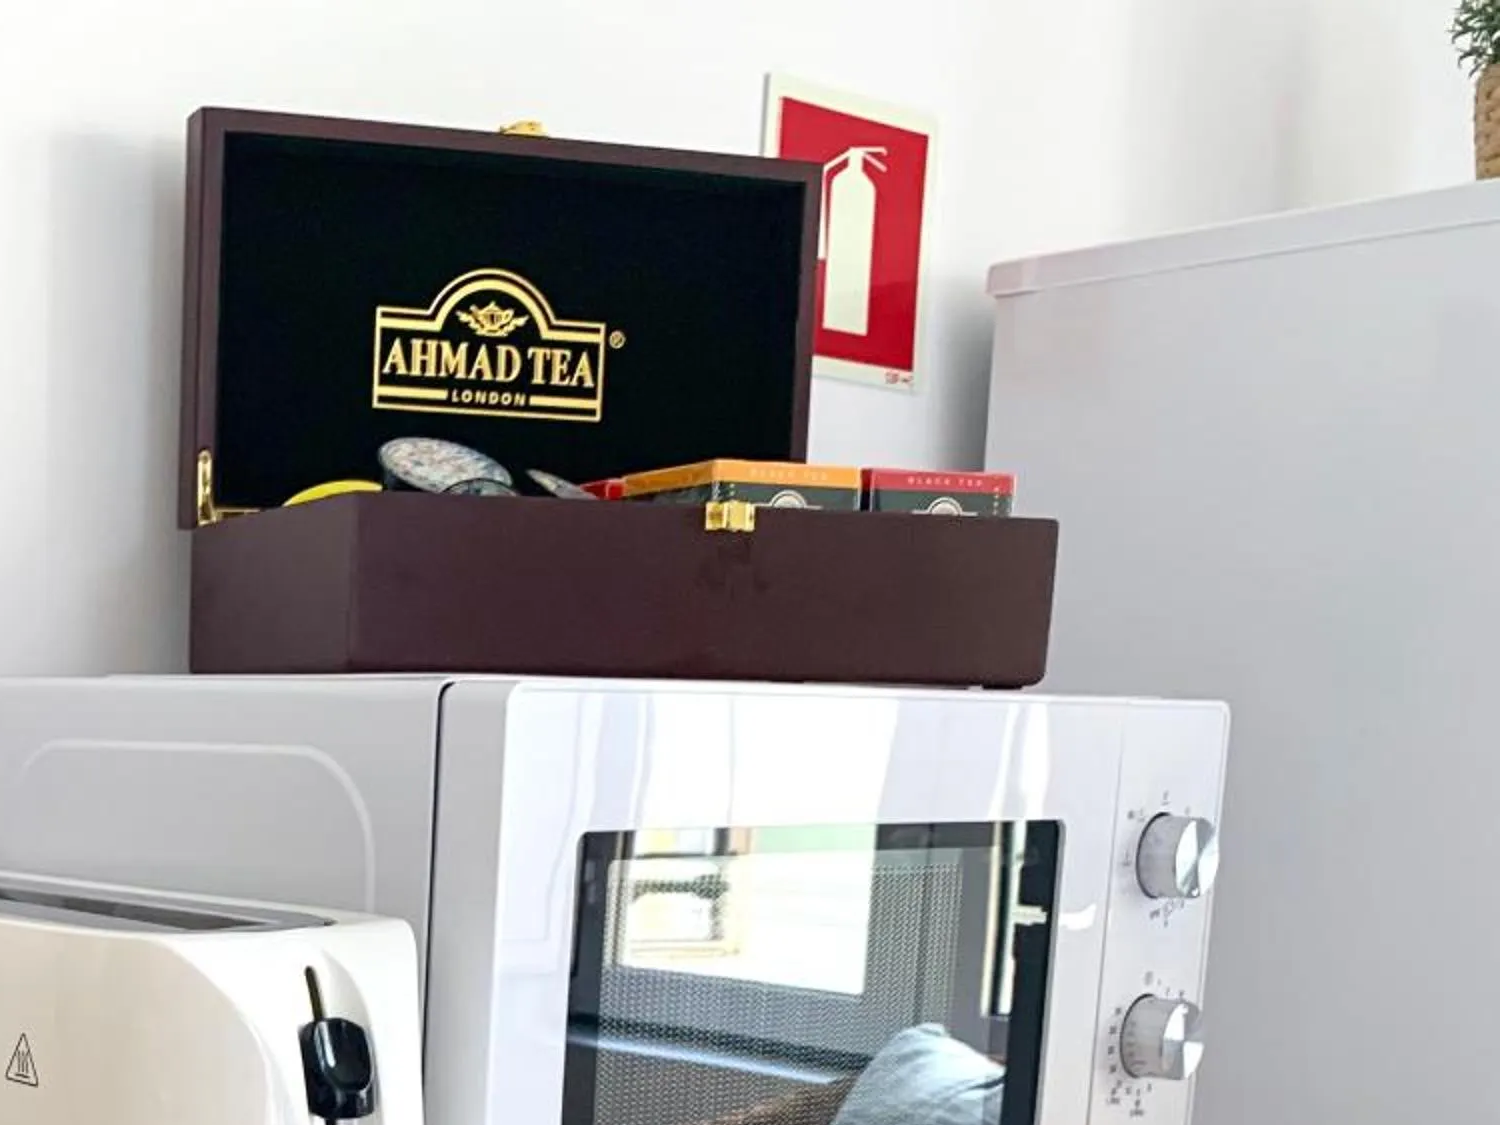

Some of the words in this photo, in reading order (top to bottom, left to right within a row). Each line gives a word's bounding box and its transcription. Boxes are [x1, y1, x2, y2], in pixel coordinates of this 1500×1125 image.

[383, 337, 521, 382] AHMAD
[527, 346, 595, 388] TEA
[451, 389, 526, 406] LONDON
